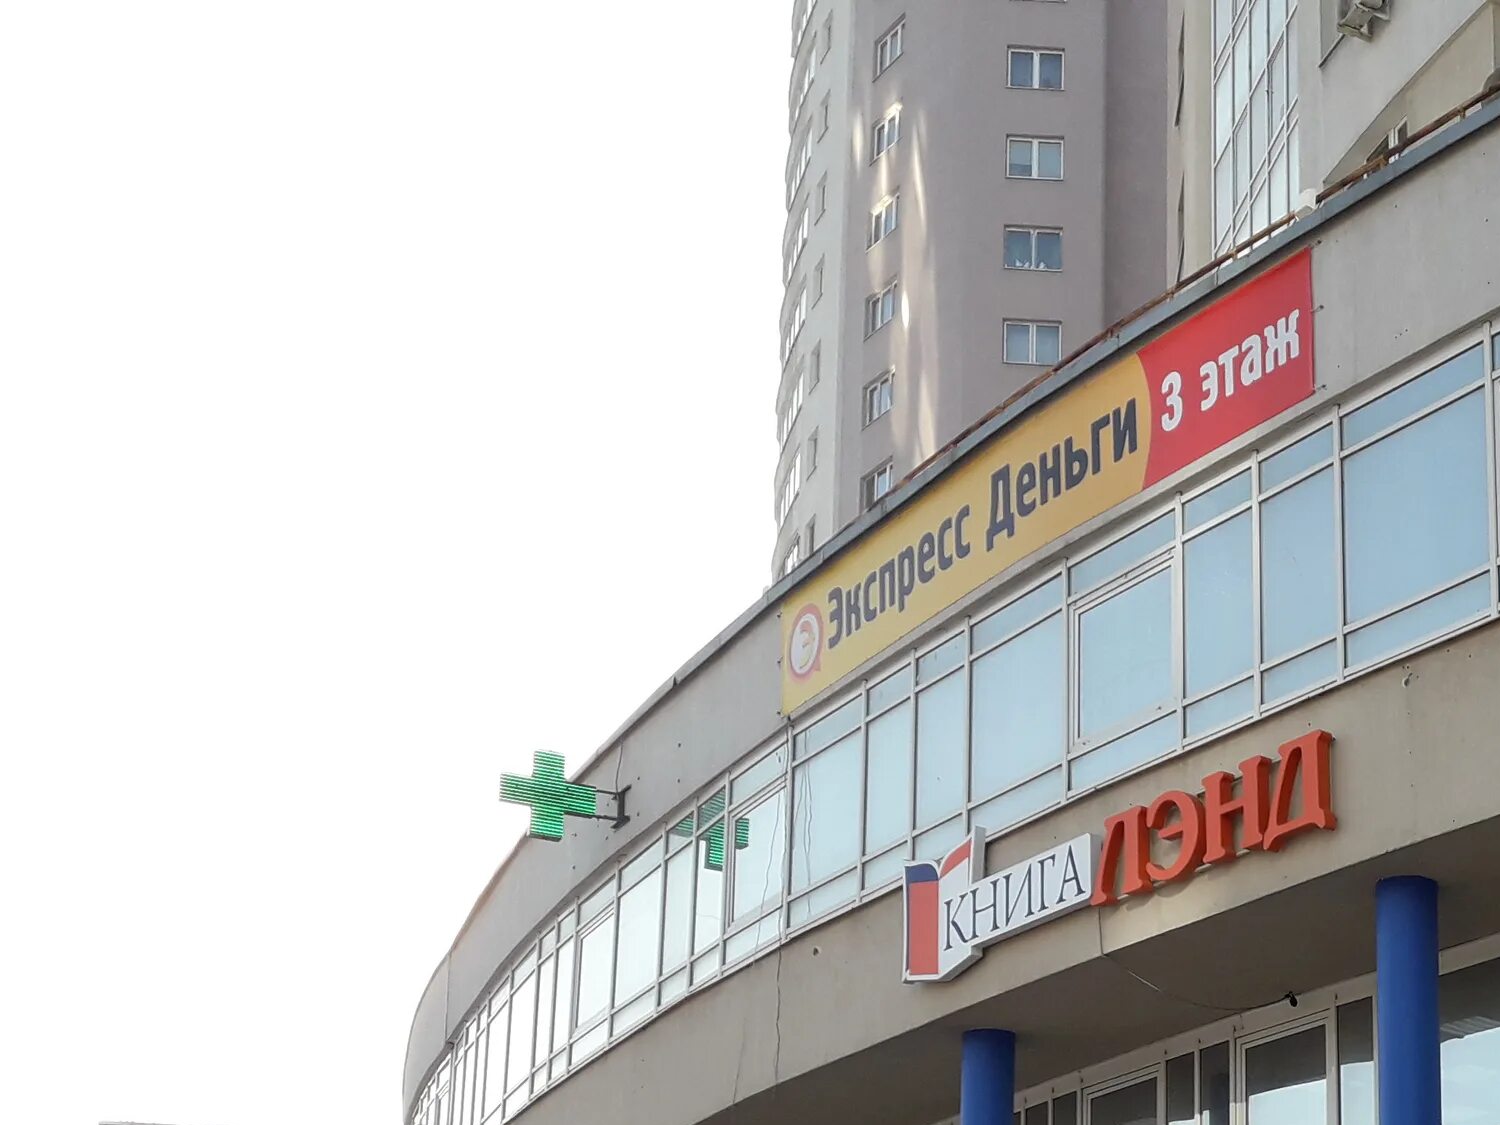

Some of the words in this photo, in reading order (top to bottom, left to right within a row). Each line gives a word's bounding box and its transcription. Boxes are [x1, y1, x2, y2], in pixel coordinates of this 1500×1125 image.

[827, 503, 970, 650] Экспресс
[985, 397, 1138, 552] Деньги
[1160, 371, 1184, 432] 3
[1199, 308, 1300, 412] этаж
